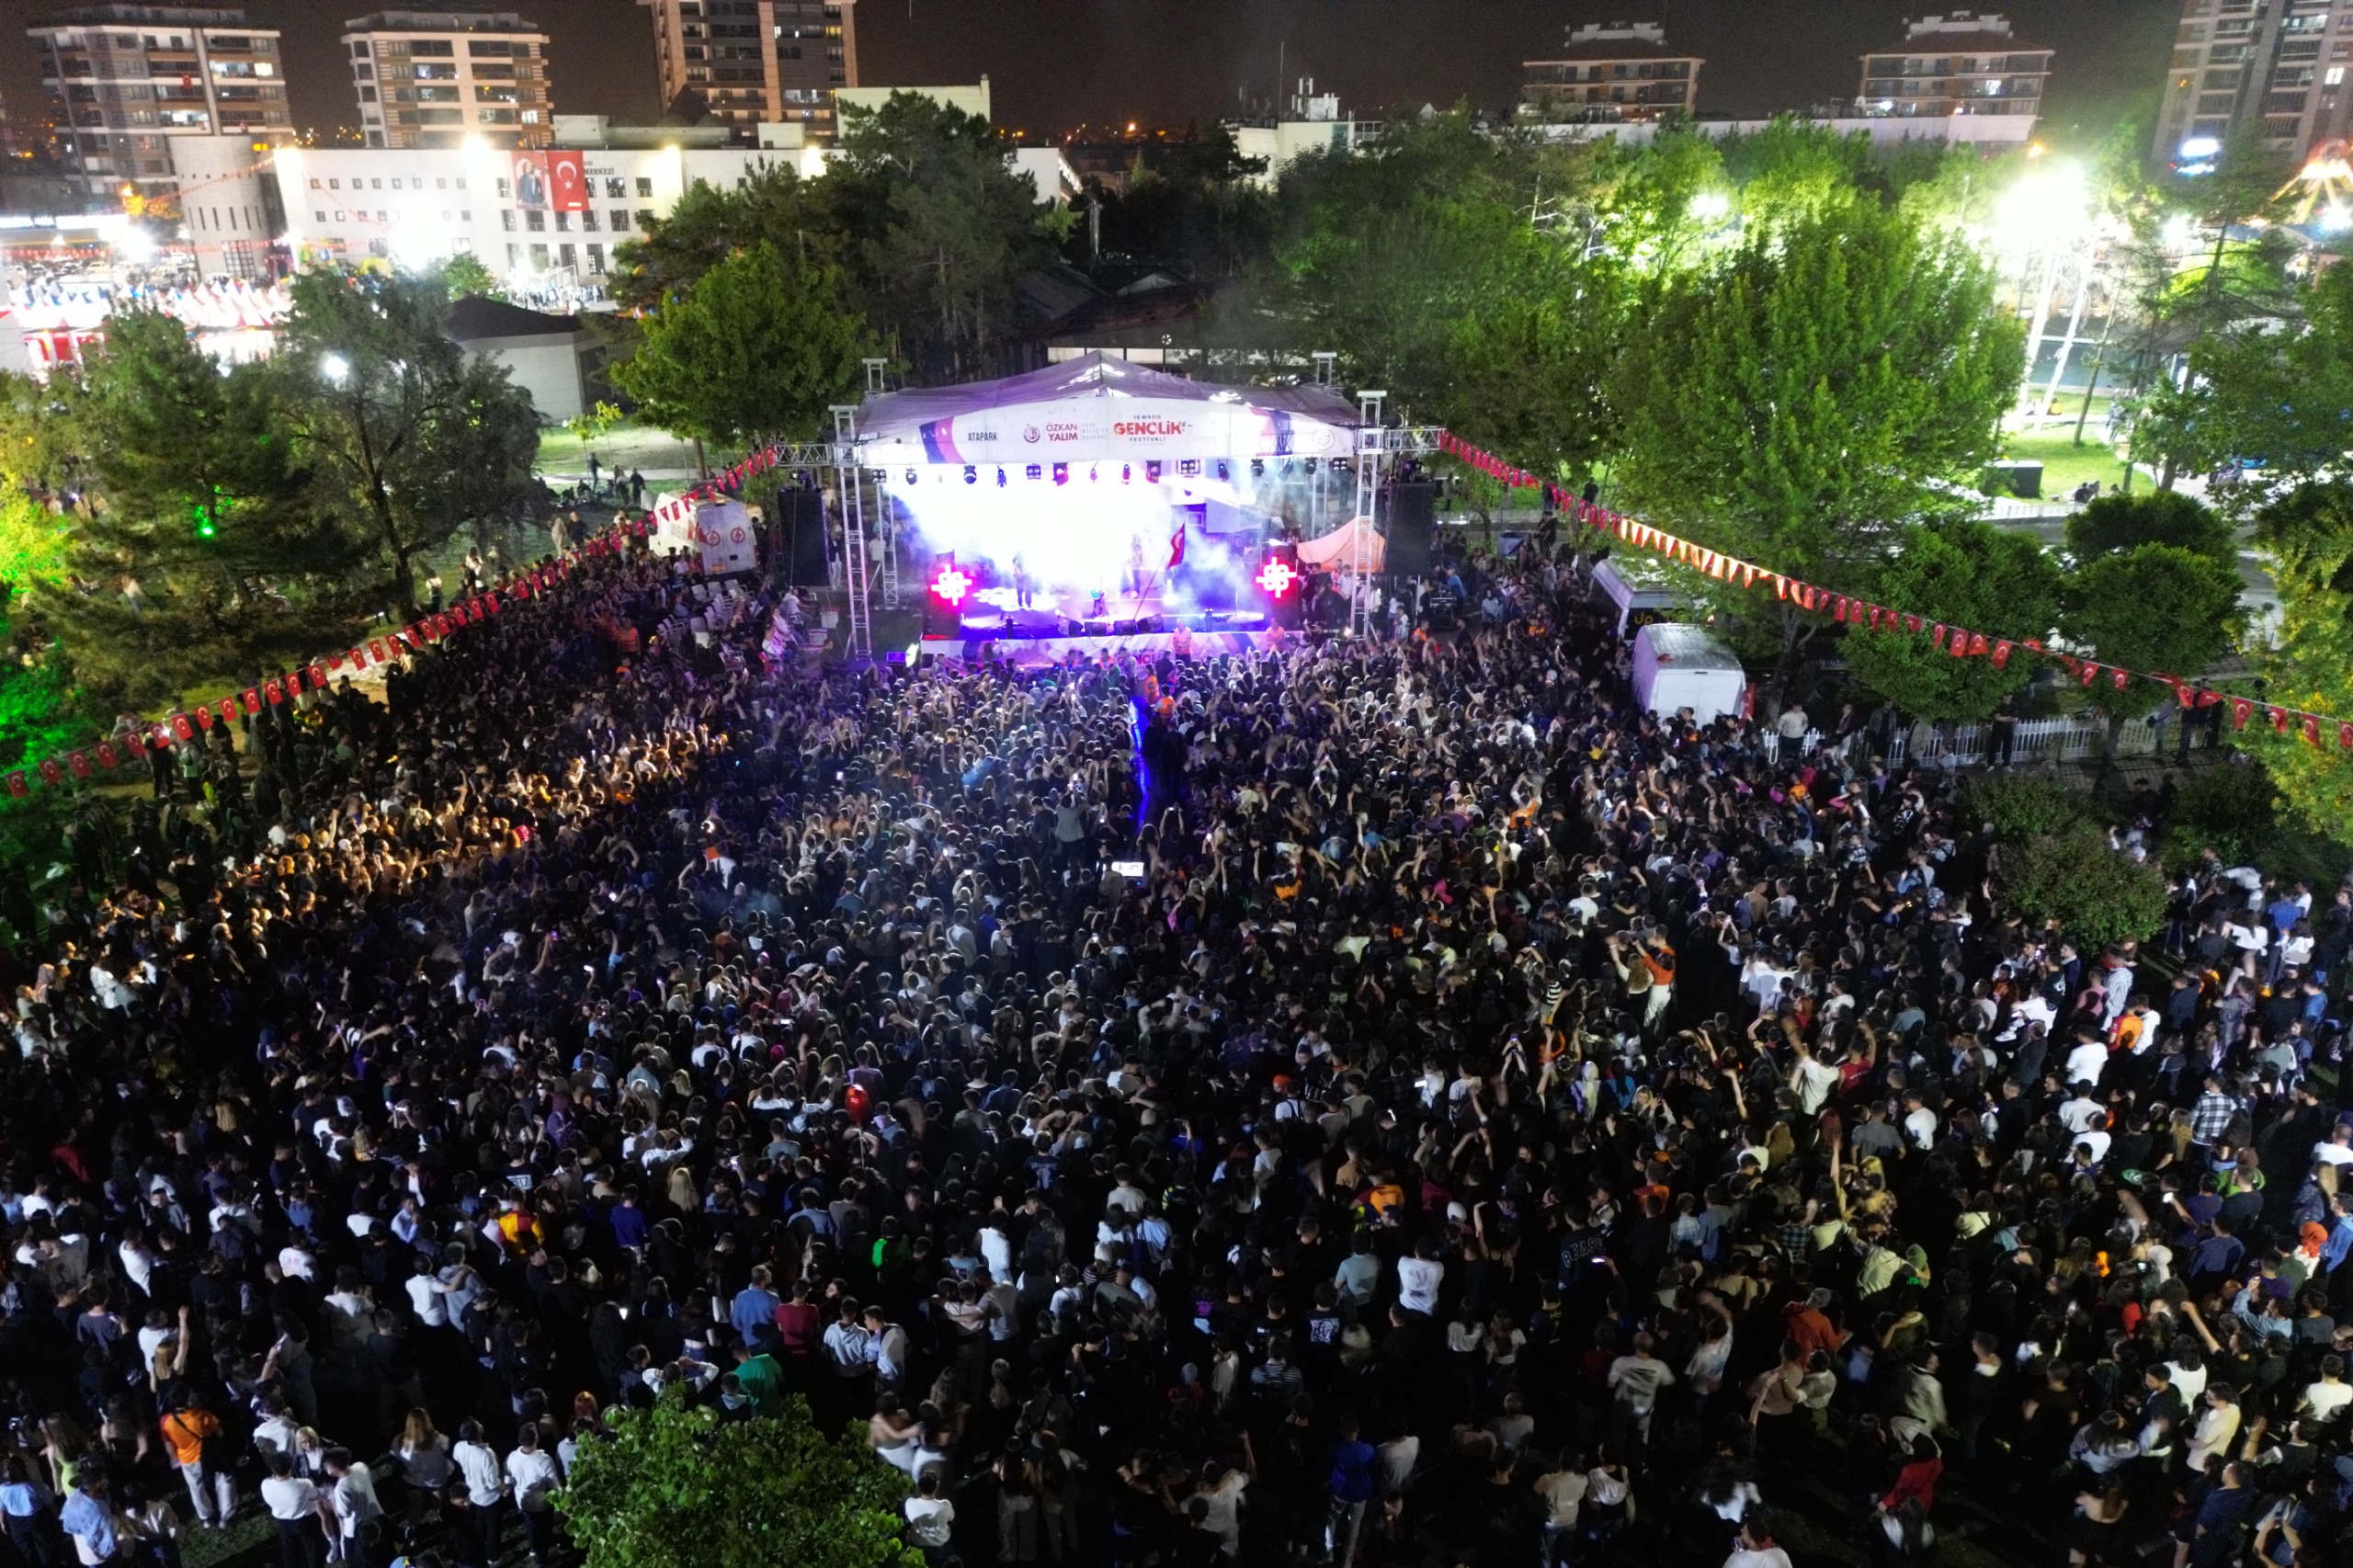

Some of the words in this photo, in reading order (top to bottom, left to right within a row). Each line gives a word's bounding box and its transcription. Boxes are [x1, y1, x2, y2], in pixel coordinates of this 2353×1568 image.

[1046, 422, 1077, 432] ÖZKAN
[968, 432, 998, 441] ATAPARK
[1048, 433, 1078, 441] YALIM
